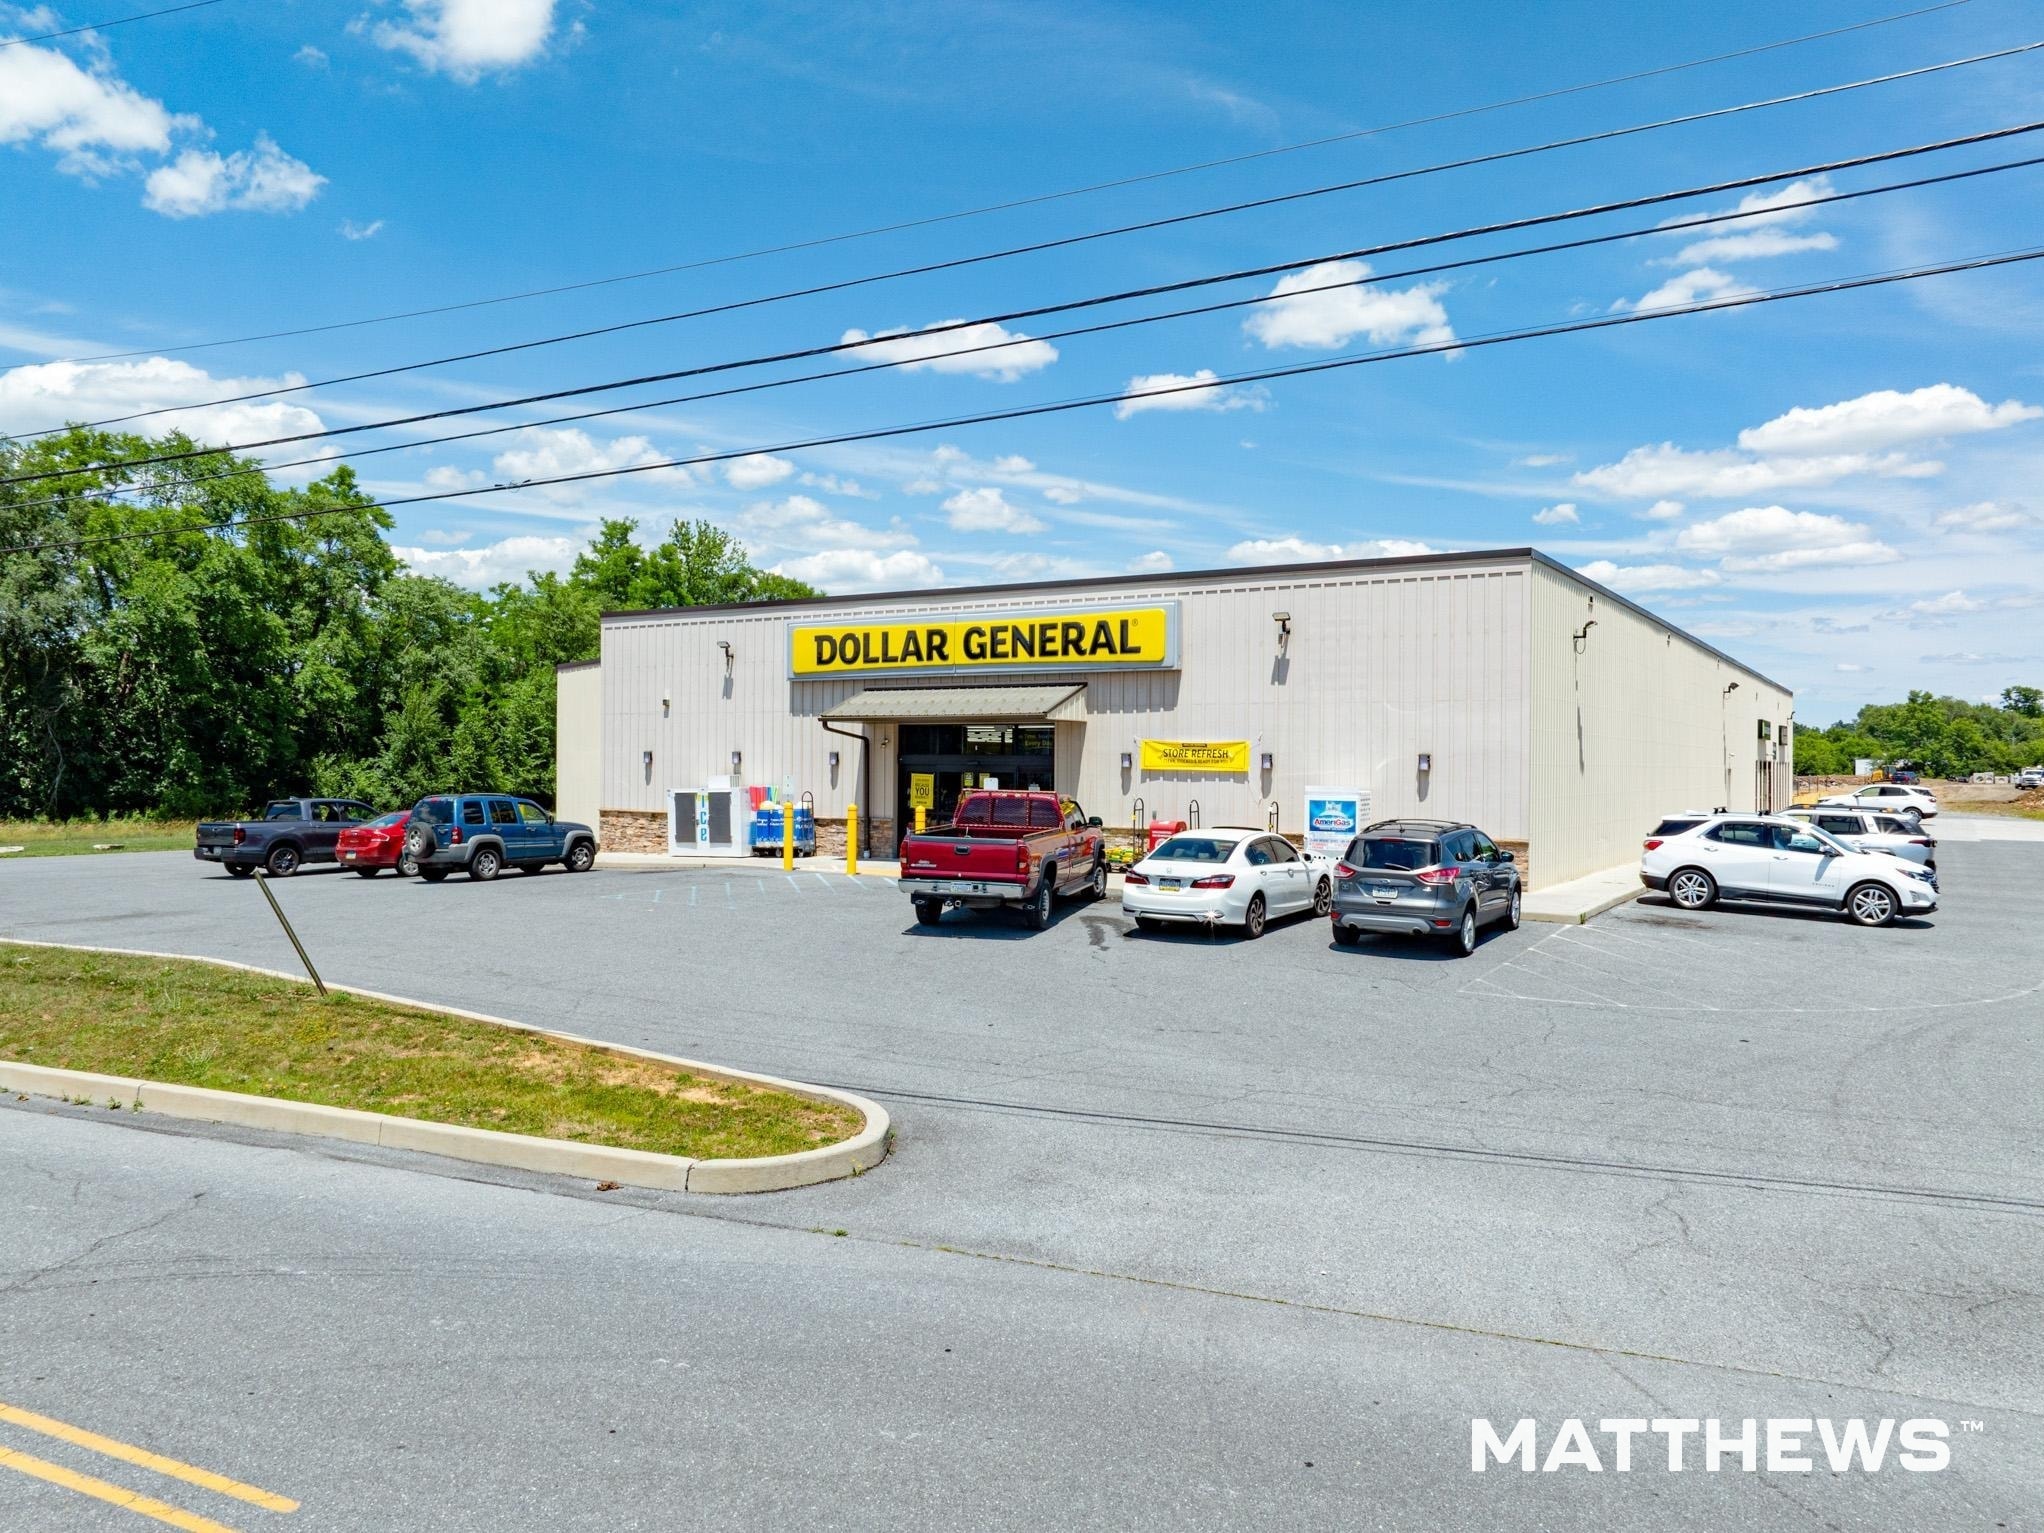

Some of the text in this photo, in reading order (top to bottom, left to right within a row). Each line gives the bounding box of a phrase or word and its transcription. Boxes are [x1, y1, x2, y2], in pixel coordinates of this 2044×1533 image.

[814, 618, 1142, 666] DOLLAR GENERAL
[1163, 748, 1229, 759] STORE REFRESH
[915, 787, 930, 796] YOU
[1314, 818, 1351, 826] AmeriGas
